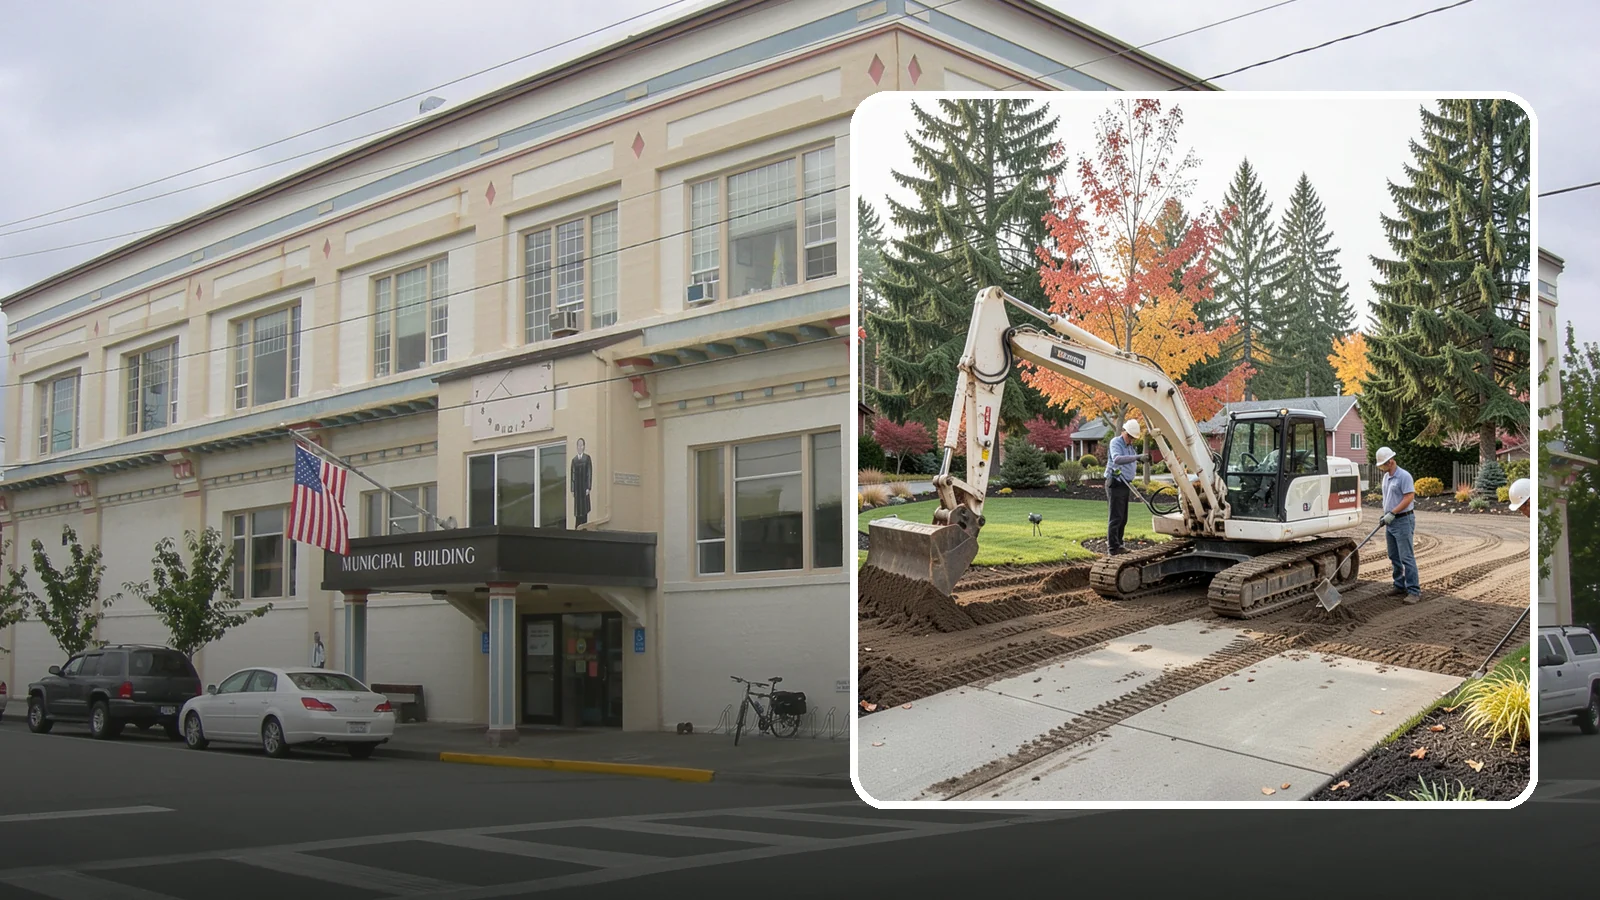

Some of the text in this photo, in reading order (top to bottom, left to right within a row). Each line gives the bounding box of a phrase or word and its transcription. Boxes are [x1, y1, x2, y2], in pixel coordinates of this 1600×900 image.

[480, 406, 484, 415] 8
[488, 418, 492, 426] 9
[494, 424, 500, 432] 10
[502, 426, 506, 434] 11
[508, 425, 513, 433] 12
[521, 420, 526, 428] 2
[528, 414, 533, 422] 3
[536, 402, 540, 410] 4
[342, 546, 475, 572] MUNICIPAL BUILDING
